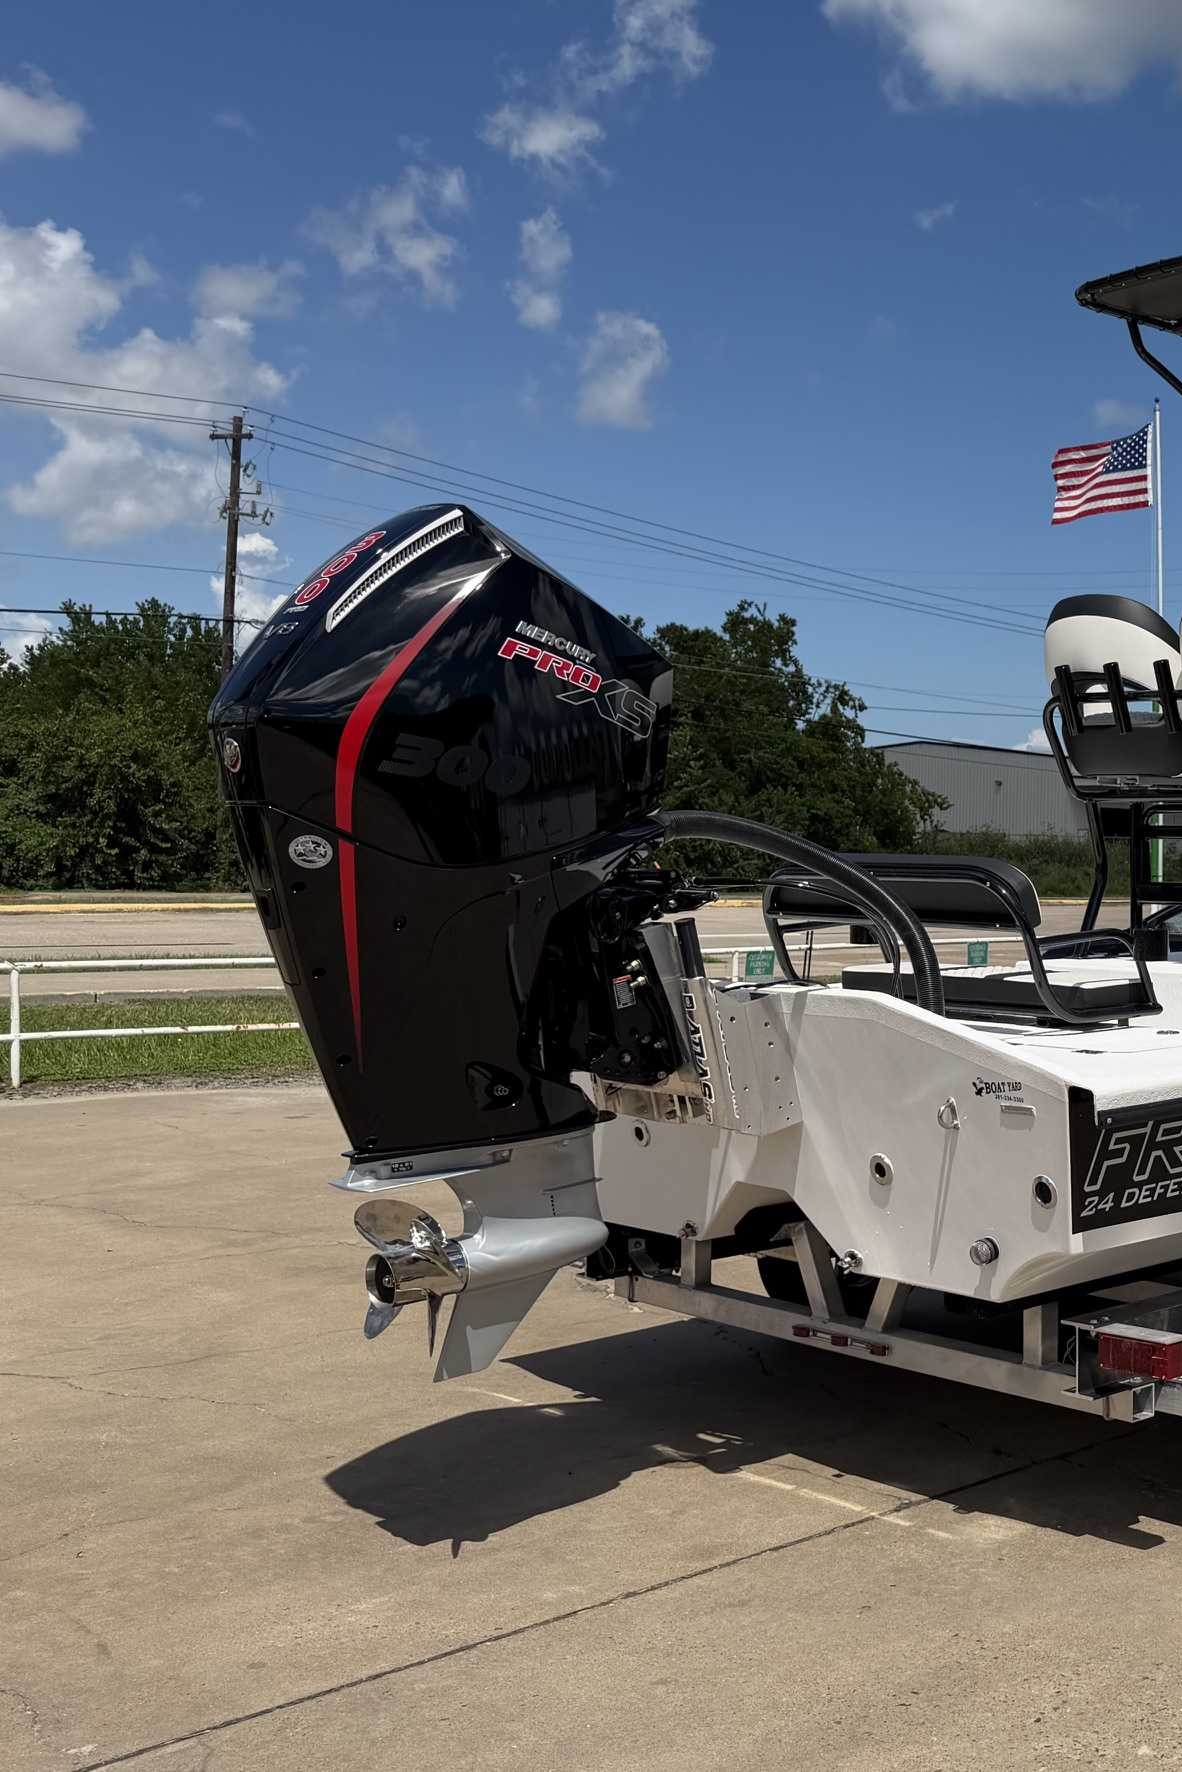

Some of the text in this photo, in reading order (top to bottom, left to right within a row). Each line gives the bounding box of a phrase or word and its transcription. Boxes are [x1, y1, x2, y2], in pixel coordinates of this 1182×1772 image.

[295, 531, 386, 605] 300
[515, 620, 597, 663] MERCURY
[498, 637, 658, 738] PRO XS
[376, 732, 531, 796] 300
[984, 1081, 1022, 1094] BOAT YARD
[1080, 1197, 1114, 1217] 24
